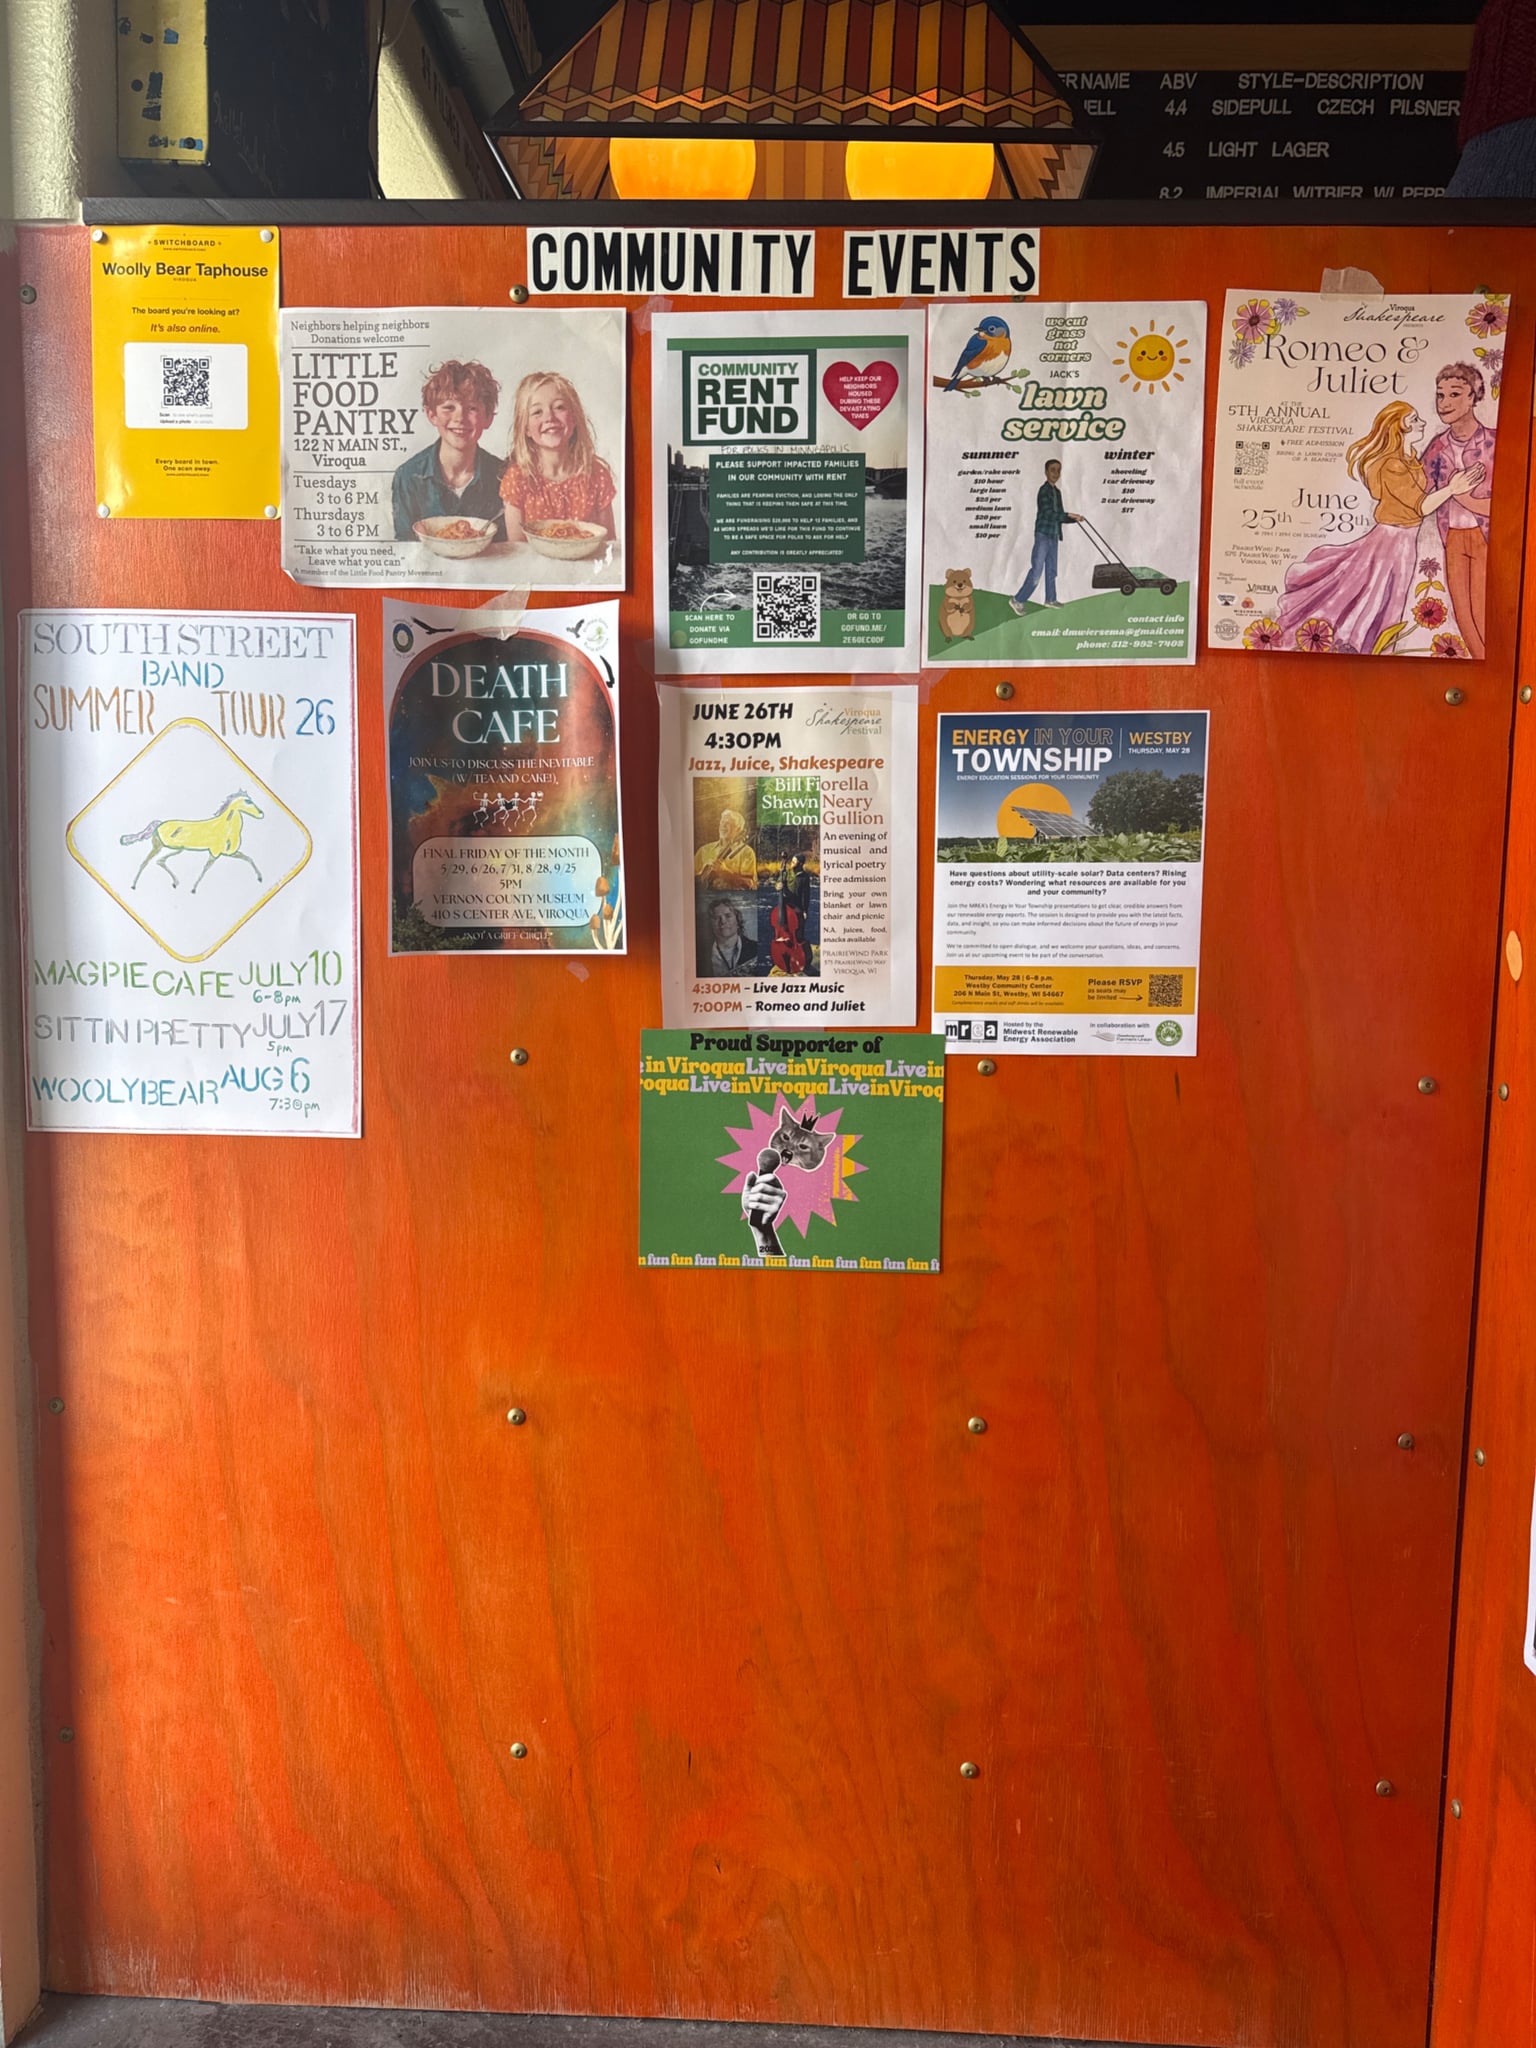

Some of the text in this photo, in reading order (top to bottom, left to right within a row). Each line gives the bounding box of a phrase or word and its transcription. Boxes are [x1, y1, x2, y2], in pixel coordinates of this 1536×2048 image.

[1081, 73, 1130, 89] NAME
[1160, 72, 1197, 90] ABV
[1238, 73, 1424, 90] STYLE-DESCRIPTION
[1211, 100, 1461, 116] SIDEPULL CZECH PILSNER
[1162, 142, 1185, 158] 4.5
[1208, 142, 1330, 158] LIGHT LAGER
[103, 262, 268, 279] Woolly Bear Taphouse
[531, 231, 1036, 295] COMMUNITY EVENTS
[132, 307, 240, 317] The board you're looking at?
[1389, 303, 1415, 312] Viroqua
[1046, 316, 1088, 327] we cut
[1344, 305, 1446, 330] Shakespeare
[150, 323, 221, 333] It's also online.
[291, 320, 430, 333] Neighbors helping neighbors
[1046, 328, 1085, 341] grass
[311, 334, 405, 344] Donations welcome
[1053, 340, 1077, 351] not
[1040, 352, 1091, 363] corners
[1264, 333, 1429, 368] Romeo &
[292, 352, 398, 379] LITTLE
[698, 362, 798, 376] COMMUNITY
[1306, 366, 1408, 395] Juliet
[293, 382, 379, 408] FOOD
[698, 377, 799, 405] RENT
[1019, 381, 1107, 411] lawn
[840, 405, 881, 413] DEVASTATING
[1228, 405, 1330, 419] 5TH ANNUAL
[293, 409, 418, 436] PANTRY
[698, 406, 799, 435] FUND
[1001, 411, 1126, 441] service
[1250, 416, 1295, 426] VIROQUA
[1236, 424, 1354, 435] SHAKESPEARE FESTIVAL
[294, 438, 407, 452] 122 N MAIN ST.,
[312, 454, 366, 469] Viroqua
[962, 450, 1019, 461] summer
[1104, 448, 1155, 461] winter
[747, 460, 782, 468] SUPPORT
[784, 460, 822, 468] IMPACTED
[824, 460, 859, 468] FAMILIES
[293, 475, 357, 491] Tuesdays
[317, 492, 379, 505] 3 to 6 PM
[1291, 488, 1360, 511] June
[293, 507, 365, 525] Thursdays
[1241, 509, 1370, 534] 25th 28th
[142, 660, 225, 688] BAND
[430, 662, 568, 699] DEATH
[33, 684, 336, 739] SUMMER TOUR 26
[692, 702, 793, 720] JUNE 26TH
[844, 708, 881, 717] Viroqua
[452, 709, 561, 744] CAFE
[806, 708, 882, 735] Shakespeare
[847, 726, 882, 735] Festival
[952, 728, 1113, 746] ENERGY IN YOUR
[1129, 731, 1192, 745] WESTBY
[704, 732, 782, 749] 4:30PM
[688, 756, 884, 773] Jazz, Juice, Shakespeare
[952, 747, 1113, 773] TOWNSHIP
[775, 777, 869, 792] Bill Fiorella
[762, 794, 873, 811] Shawn Neary
[782, 811, 884, 825] Tom Gullion
[823, 831, 888, 844] An evening of
[423, 848, 589, 859] FINAL FRIDAY OF THE MONTH
[823, 846, 888, 855] musical and
[823, 860, 886, 871] lyrical poetry
[823, 875, 886, 883] Free admission
[970, 870, 1006, 879] questions
[1032, 869, 1078, 879] utility-scale
[1162, 870, 1186, 879] Rising
[499, 879, 522, 889] 5PM
[433, 893, 584, 904] VERNON COUNTY MUSEUM
[34, 950, 342, 998] MAGPIE CAFE JULY 10
[1088, 978, 1143, 987] Please RSVP
[33, 999, 347, 1049] SITTIN PRETTY JULY 17
[690, 1033, 884, 1057] Proud Supporter of
[221, 1057, 310, 1094] AUG 6
